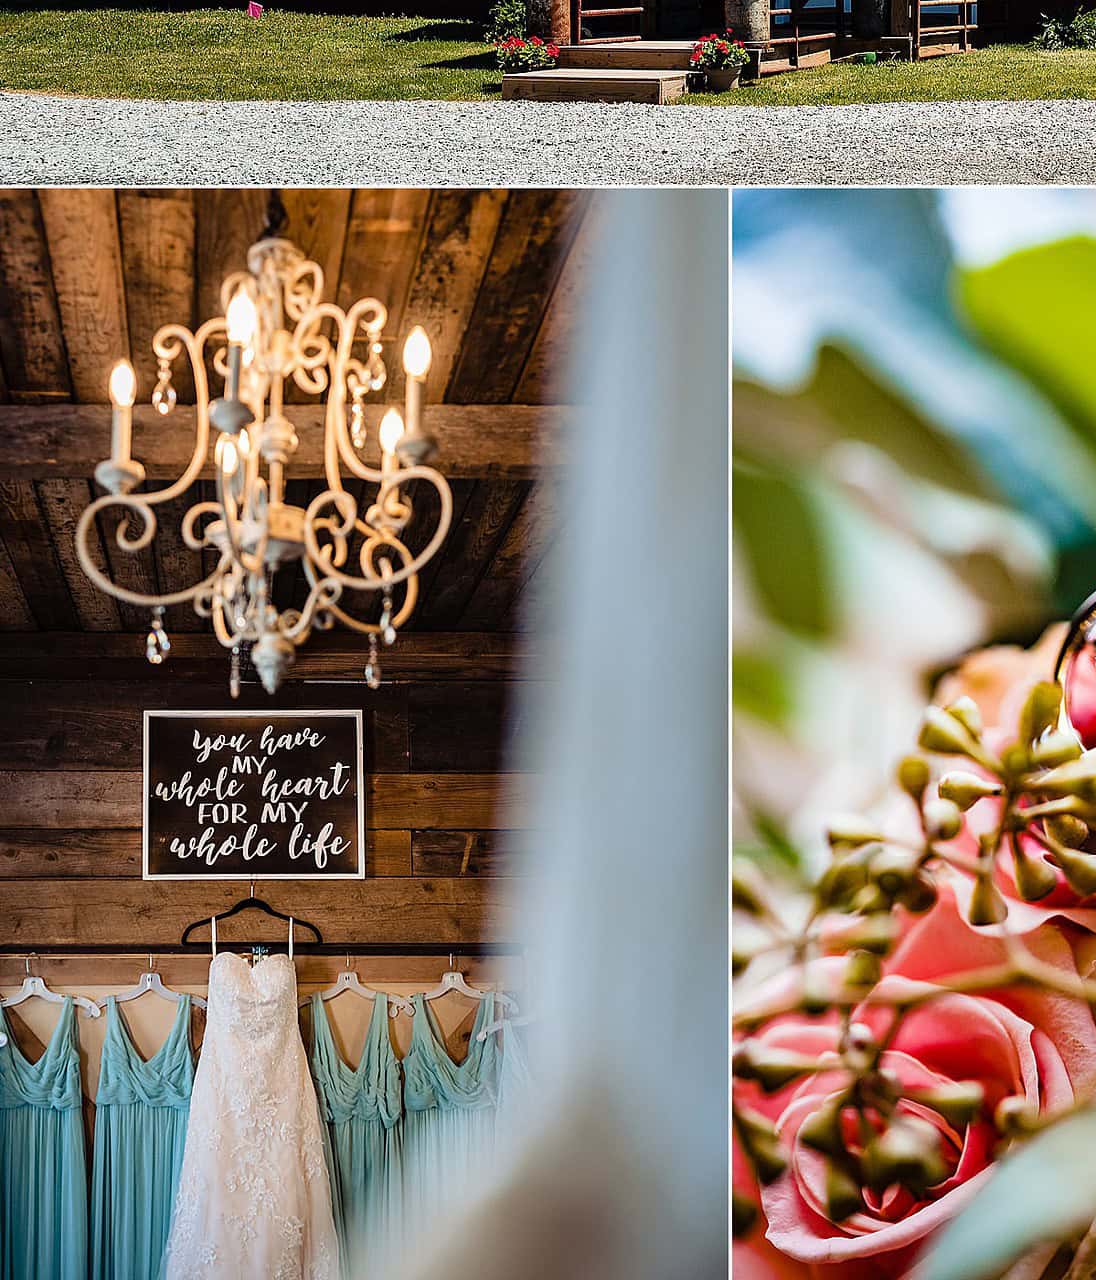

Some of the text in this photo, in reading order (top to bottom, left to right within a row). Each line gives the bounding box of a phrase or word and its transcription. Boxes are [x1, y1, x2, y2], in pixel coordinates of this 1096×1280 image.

[192, 725, 326, 762] you have
[232, 756, 267, 774] MY
[155, 762, 350, 806] whole heart
[198, 802, 308, 824] FOR MY
[170, 822, 352, 868] whole life
